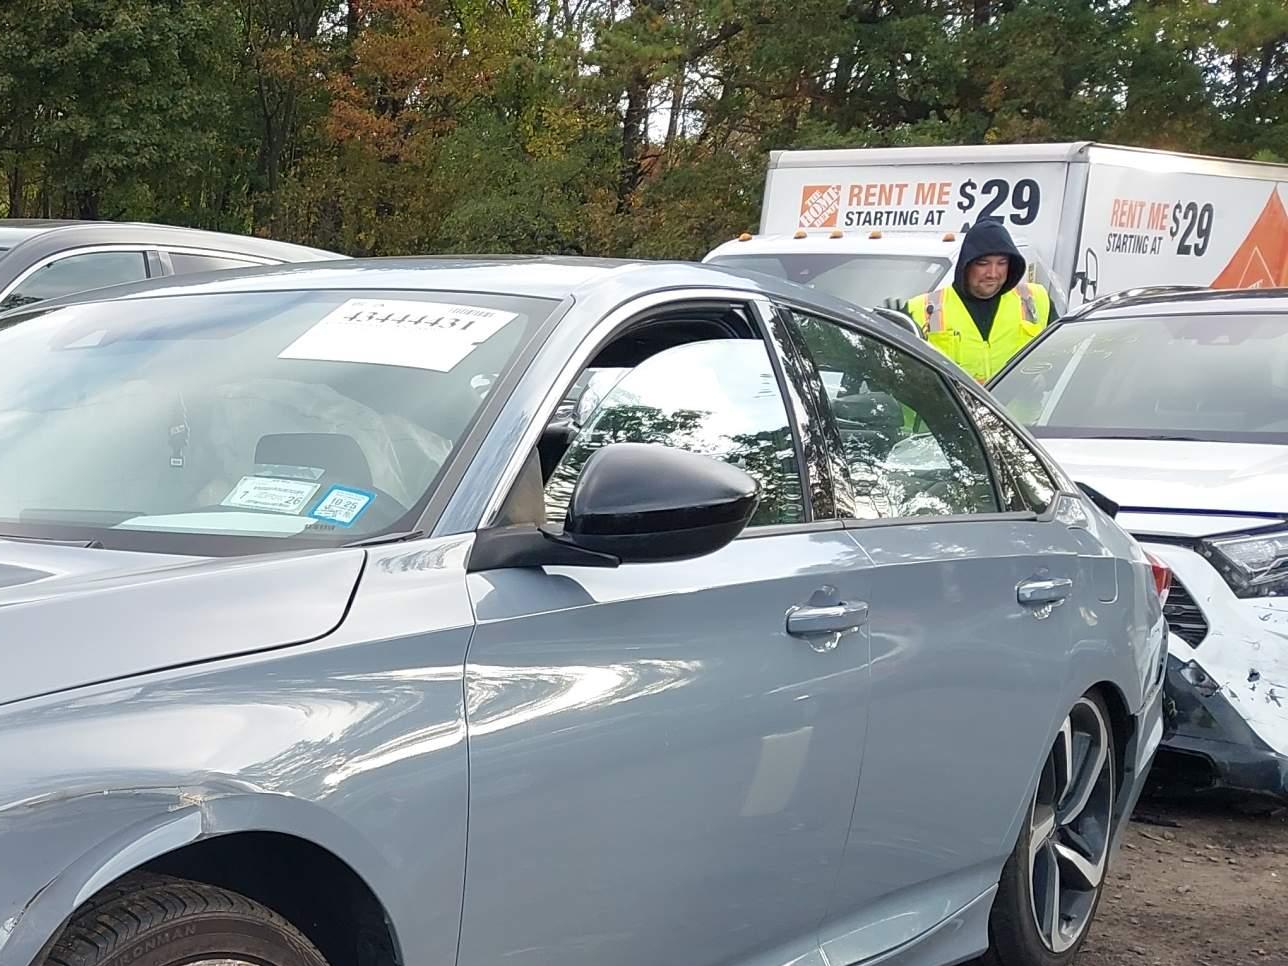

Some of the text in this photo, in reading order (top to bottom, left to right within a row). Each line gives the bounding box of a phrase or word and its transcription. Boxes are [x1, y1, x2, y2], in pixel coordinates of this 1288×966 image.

[847, 182, 953, 207] RENT ME
[956, 178, 1041, 226] $29
[844, 209, 946, 227] STARTING AT
[1110, 198, 1170, 231] RENT ME
[1169, 199, 1214, 257] $29
[1106, 233, 1164, 255] STARTING AT
